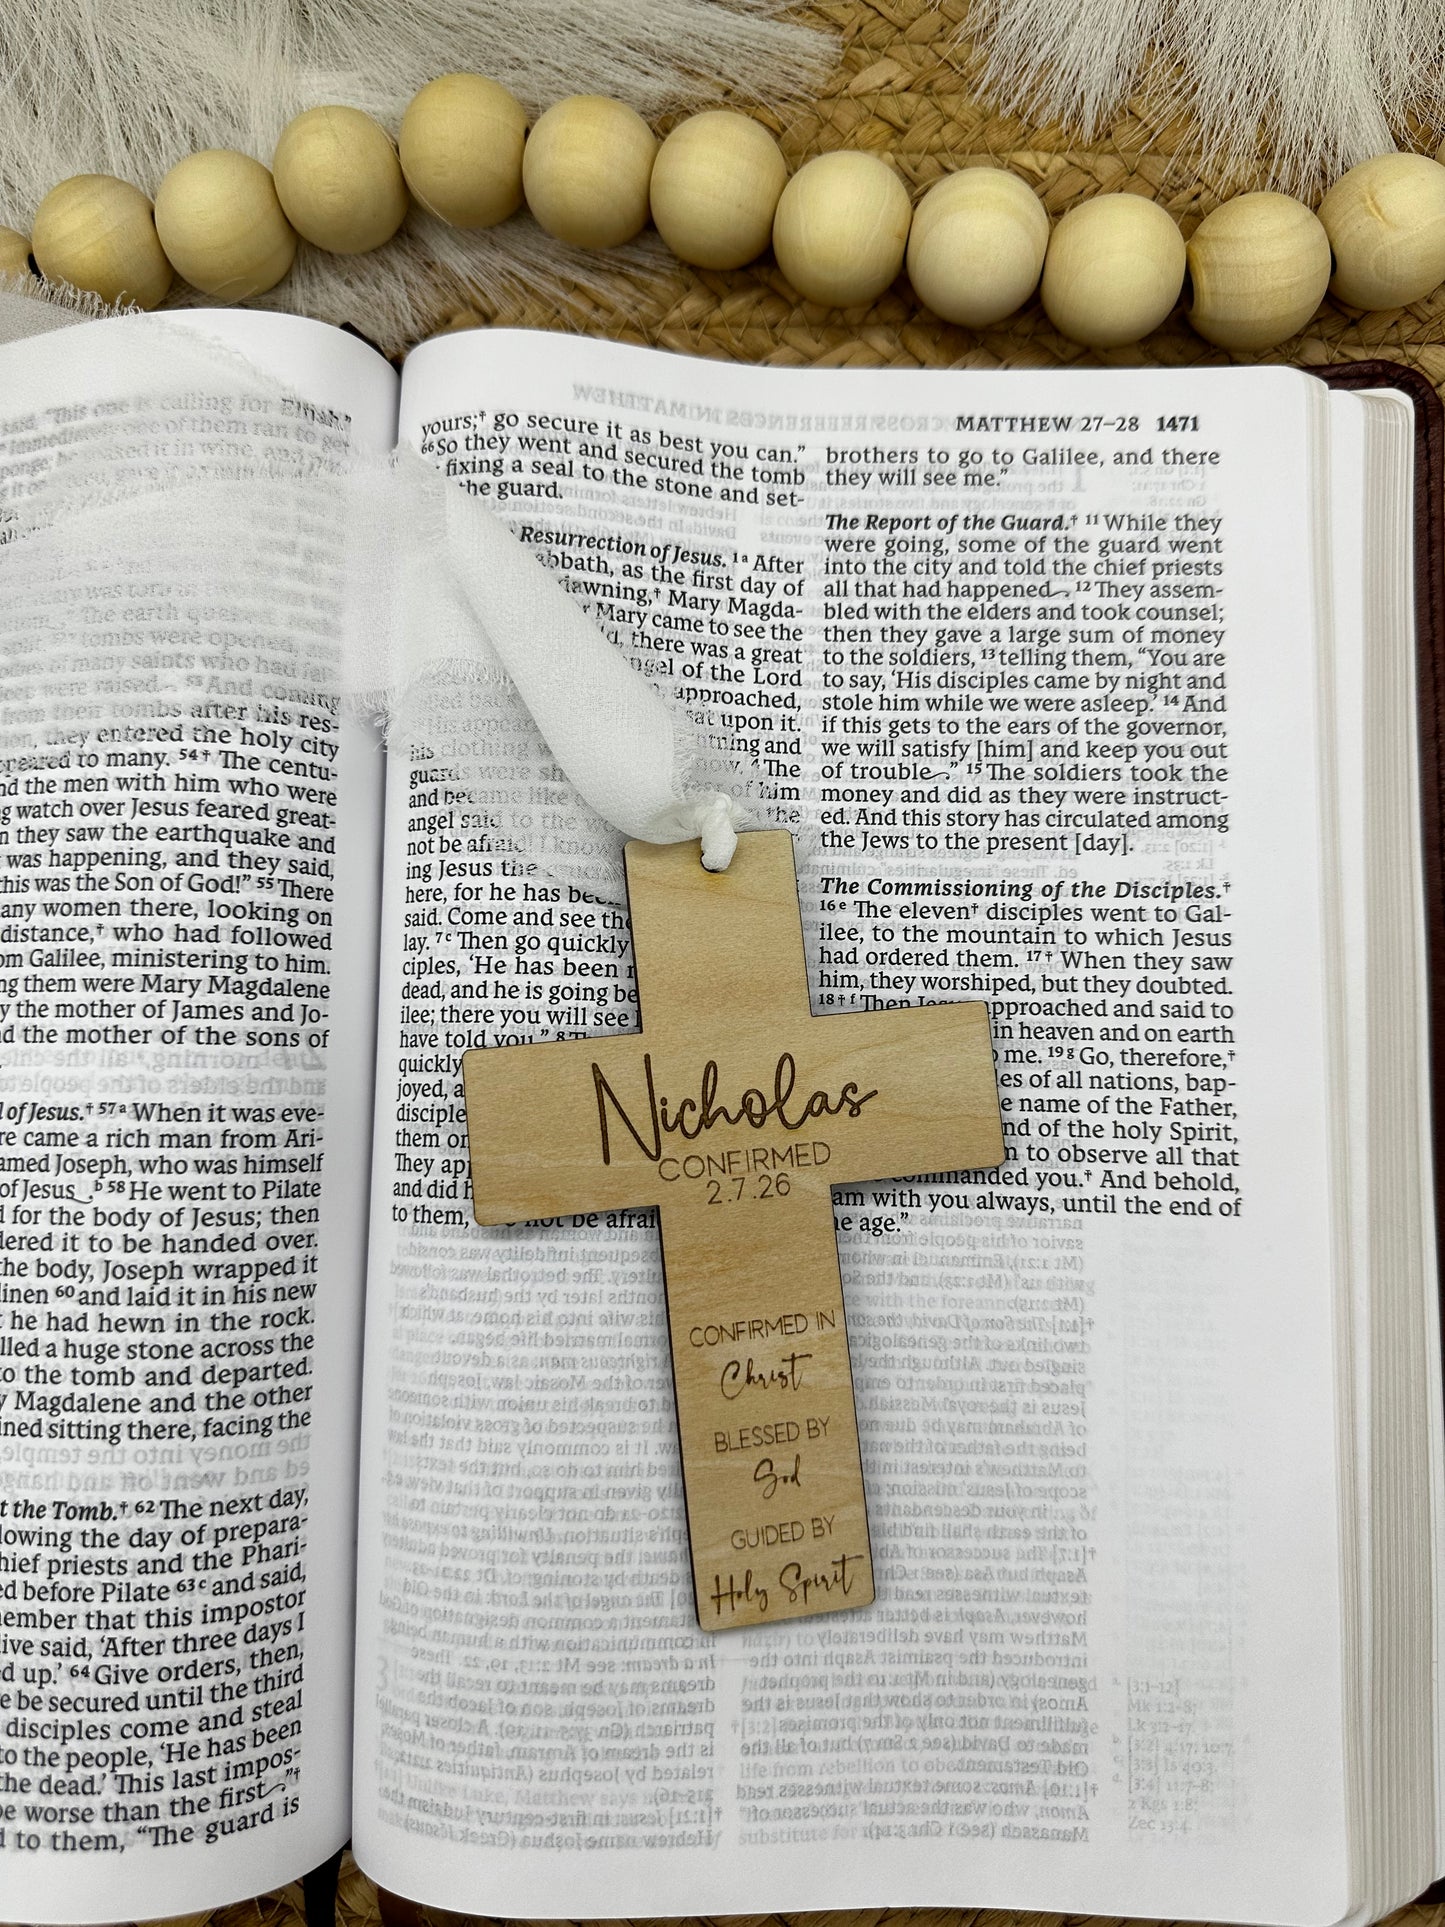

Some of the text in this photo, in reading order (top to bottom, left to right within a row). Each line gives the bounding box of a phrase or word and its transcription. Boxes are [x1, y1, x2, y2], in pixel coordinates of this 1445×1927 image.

[494, 413, 519, 431] go
[527, 416, 598, 435] secure
[607, 421, 622, 439] it
[630, 430, 650, 444] as
[660, 431, 703, 453] best
[711, 443, 748, 459] you
[957, 417, 1072, 432] MATTHEW
[1158, 416, 1198, 431] 1471
[827, 447, 1219, 468] brothers to go to Galilee, and there
[826, 514, 859, 530] The
[865, 515, 931, 534] Report
[937, 514, 959, 534] of
[963, 514, 995, 530] the
[1104, 514, 1166, 531] While
[1175, 514, 1222, 535] they
[520, 526, 804, 574] Resurrection of Jesus. After
[596, 602, 803, 641] Mary came to see the
[823, 672, 843, 688] to
[849, 675, 885, 692] say,
[937, 671, 1028, 693] disciples
[1034, 676, 1089, 689] came
[1095, 672, 1120, 693] by
[1126, 672, 1181, 694] night
[1187, 672, 1226, 689] and
[25, 773, 337, 806] the men with him who were
[821, 786, 1228, 808] money and did as they were instruct-
[17, 823, 335, 854] they saw the earthquake and
[821, 877, 859, 894] The
[868, 879, 1033, 901] Commissioning
[1041, 881, 1065, 902] of
[1072, 881, 1106, 898] the
[405, 908, 442, 927] said.
[448, 907, 507, 925] Come
[513, 908, 554, 926] and
[560, 913, 595, 928] see
[113, 923, 163, 941] who
[174, 924, 221, 943] had
[231, 925, 332, 950] followed
[820, 923, 1231, 950] ilee, to the mountain to which Jesus
[24, 974, 330, 1000] them were Mary Magdalene
[402, 980, 608, 1006] dead, and he is going
[819, 970, 1232, 998] him, they worshiped, but they doubted.
[592, 1053, 878, 1165] Nicholas
[24, 1128, 323, 1148] came a rich man from Ari-
[658, 1141, 831, 1181] CONFIRMED
[706, 1173, 791, 1205] 2.7.26
[872, 1188, 921, 1207] with
[928, 1194, 969, 1213] you
[977, 1191, 1054, 1216] always,
[1062, 1194, 1116, 1213] until
[1124, 1195, 1162, 1214] the
[1169, 1197, 1212, 1216] end
[1219, 1198, 1242, 1216] of
[62, 1232, 318, 1253] it to be handed over.
[11, 1306, 314, 1333] he had hewn in the rock.
[690, 1310, 836, 1348] CONFIRMED IN
[25, 1356, 312, 1388] the tomb and departed.
[720, 1352, 813, 1400] Christ
[714, 1416, 830, 1453] BLESSED BY
[753, 1454, 801, 1499] God
[81, 1516, 308, 1552] the day of prepara-
[731, 1515, 835, 1550] GUIDED BY
[711, 1553, 864, 1615] Holy Spirit
[6, 1693, 302, 1744] disciples come and steal
[16, 1832, 40, 1850] to
[52, 1831, 124, 1853] them,
[205, 1802, 274, 1844] guard
[283, 1797, 299, 1817] is
